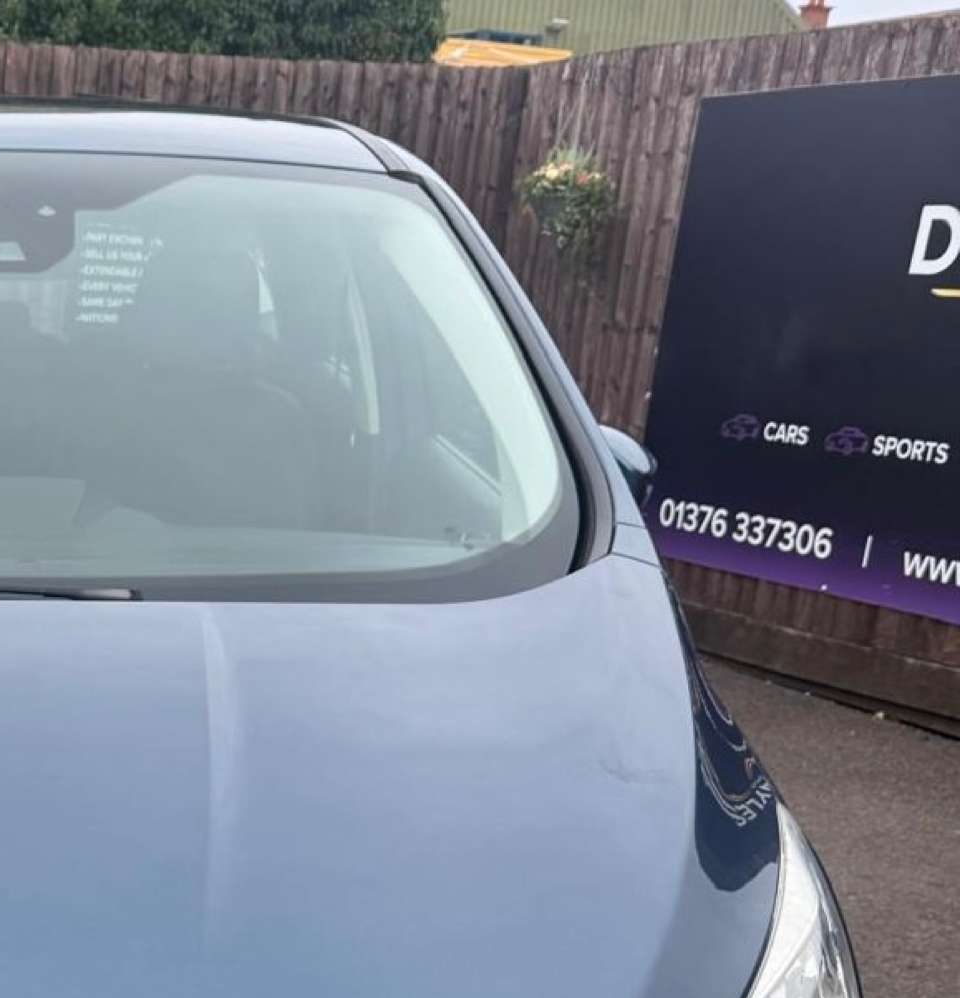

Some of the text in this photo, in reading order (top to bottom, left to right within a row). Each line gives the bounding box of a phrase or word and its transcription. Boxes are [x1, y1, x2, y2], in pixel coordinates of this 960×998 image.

[763, 421, 950, 465] CARS SPORTS
[659, 498, 960, 588] 01376 337306 ww
